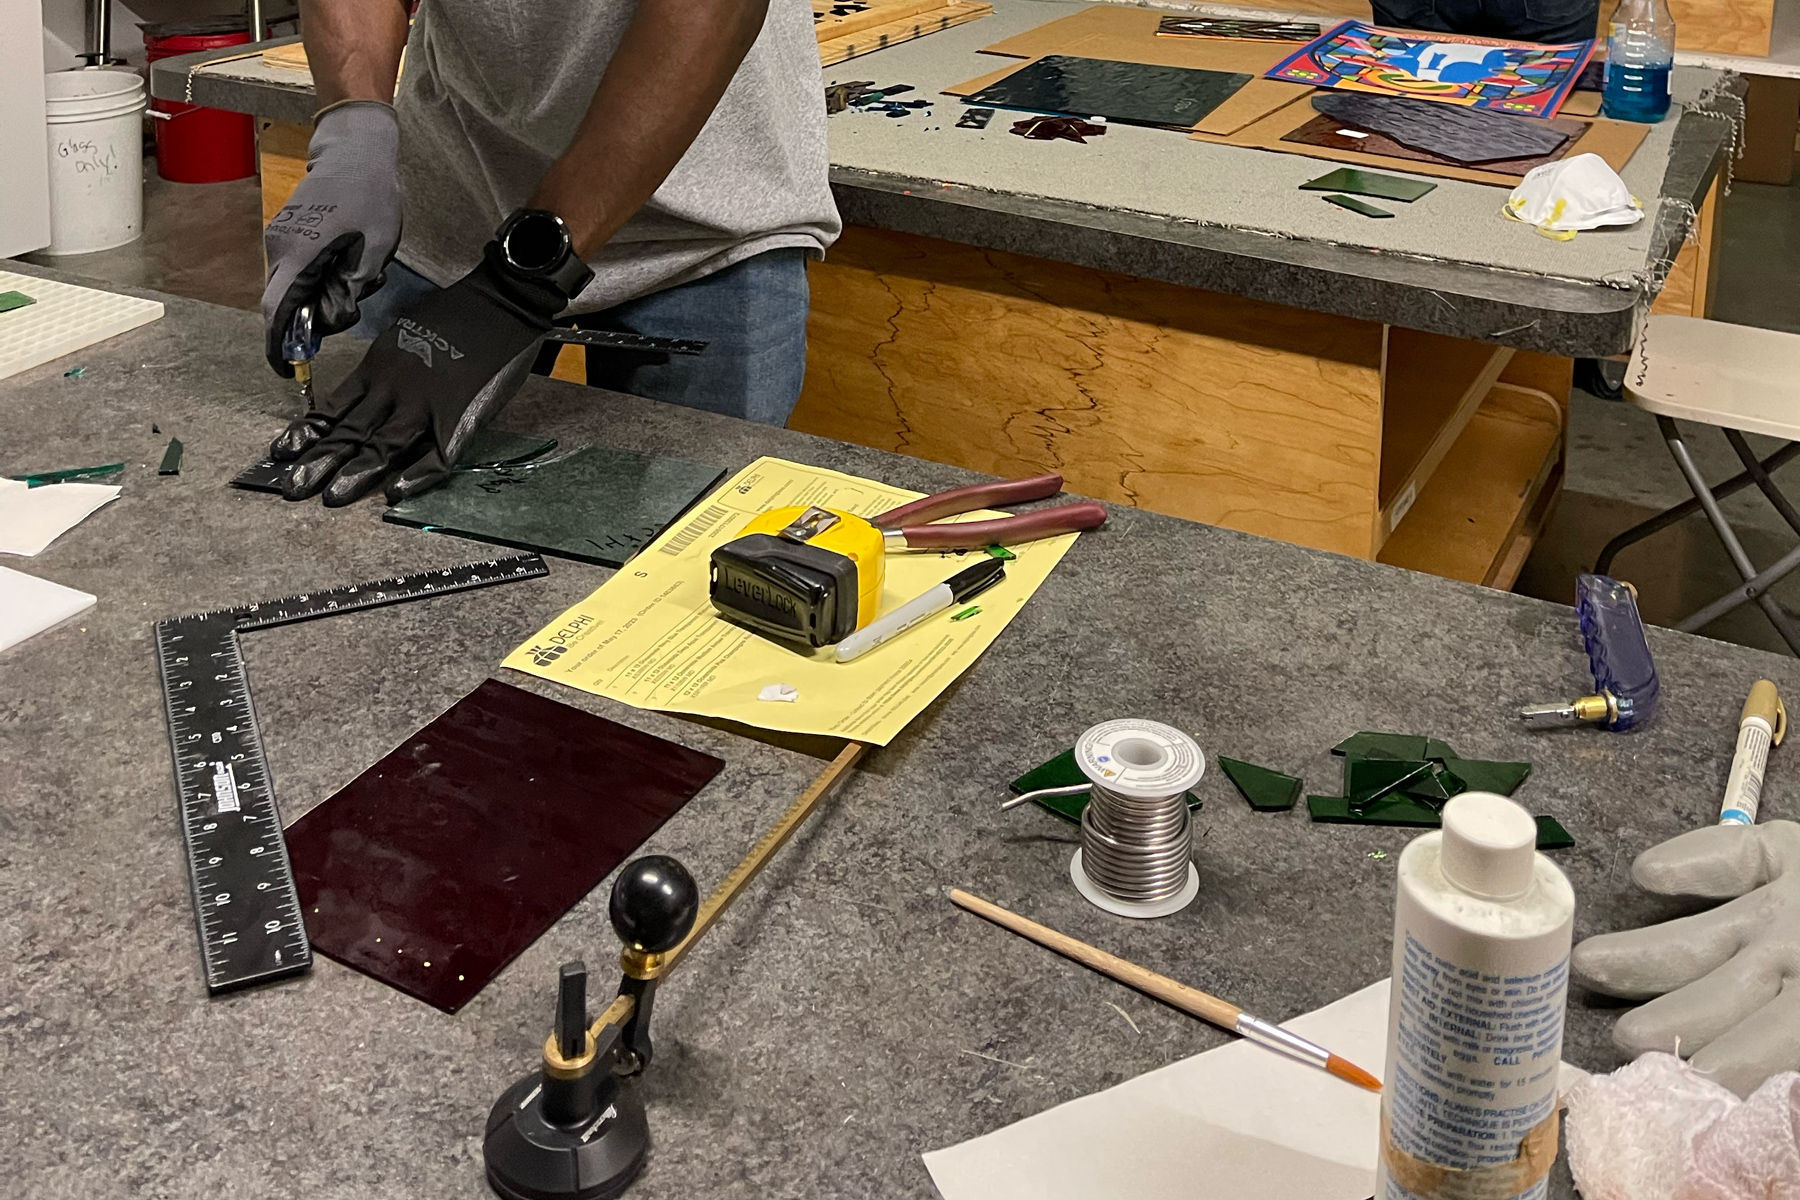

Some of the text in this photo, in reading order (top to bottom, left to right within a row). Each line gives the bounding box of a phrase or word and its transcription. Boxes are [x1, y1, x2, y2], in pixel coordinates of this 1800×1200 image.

[723, 564, 797, 617] LeverLock
[549, 614, 594, 645] DELPHI
[231, 753, 244, 761] 5
[1084, 743, 1105, 774] WARNING
[237, 782, 251, 790] 6
[203, 822, 218, 831] 8
[250, 846, 264, 855] 8
[208, 856, 223, 865] 9
[257, 882, 272, 890] 9
[215, 892, 231, 907] 10
[265, 920, 281, 935] 10
[222, 931, 238, 945] 11
[1493, 1056, 1521, 1067] CALL
